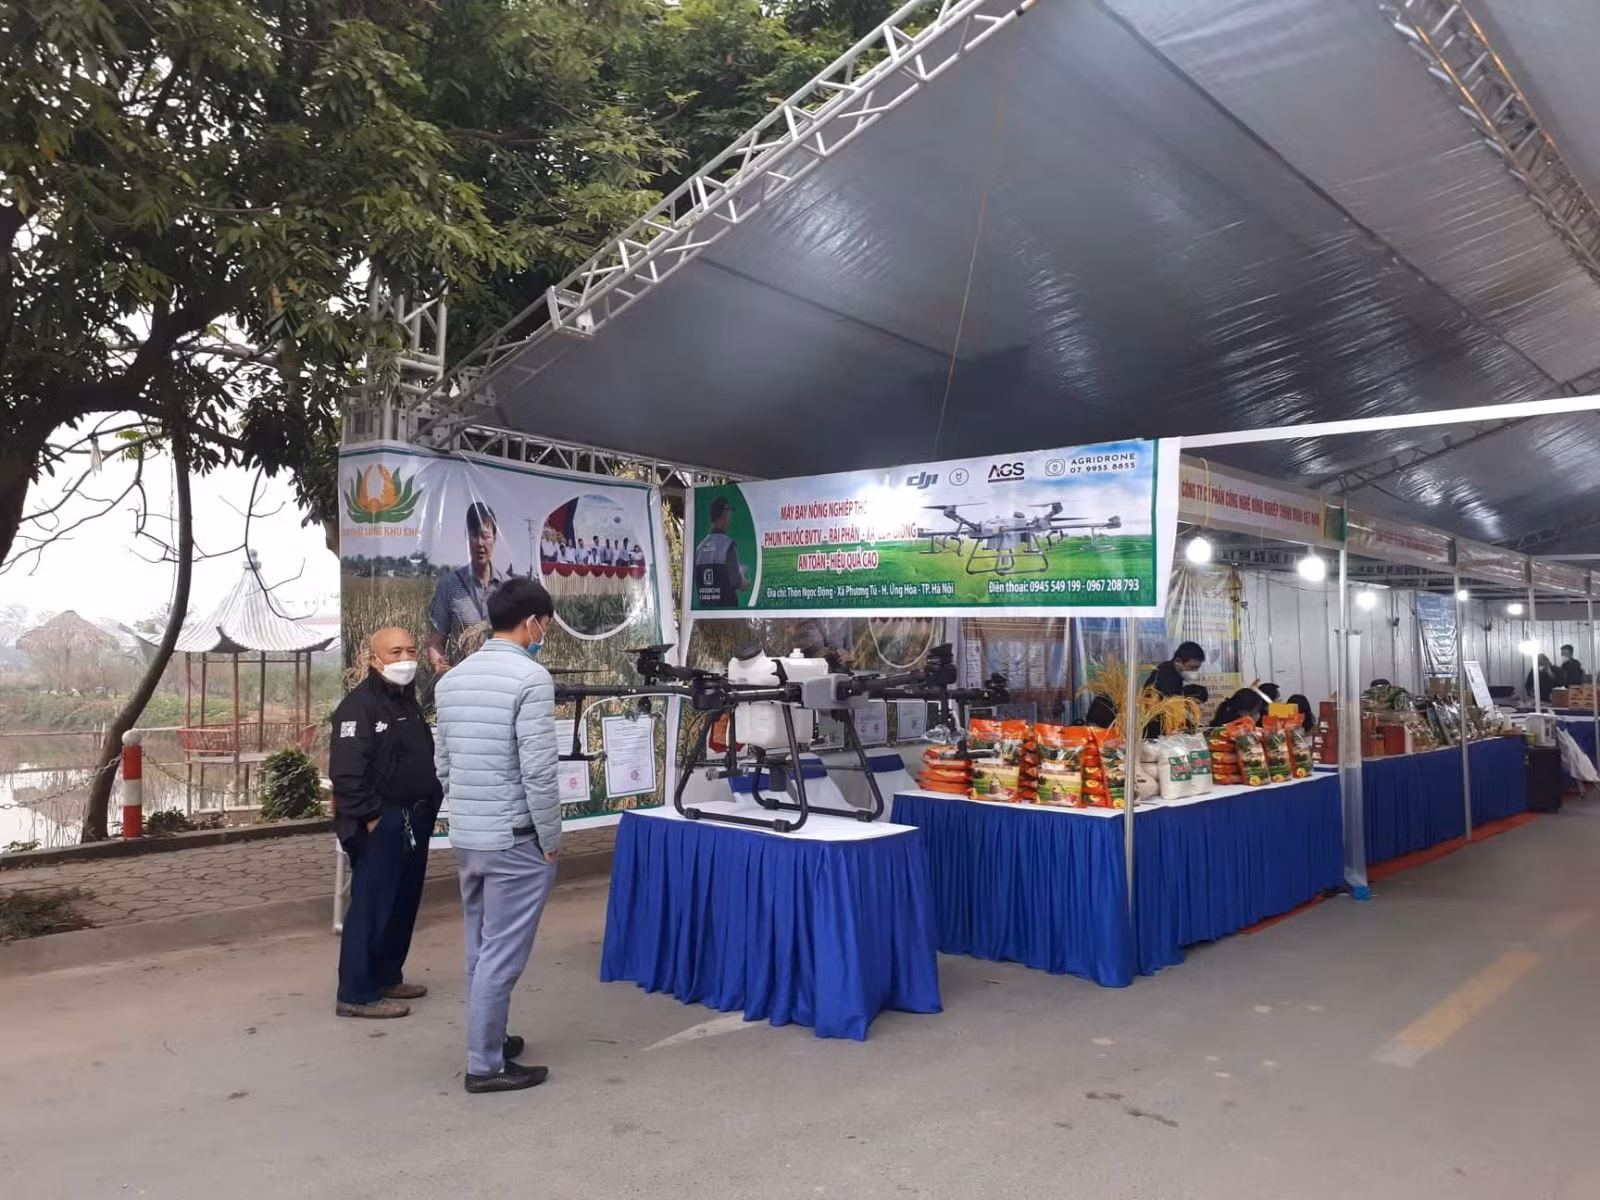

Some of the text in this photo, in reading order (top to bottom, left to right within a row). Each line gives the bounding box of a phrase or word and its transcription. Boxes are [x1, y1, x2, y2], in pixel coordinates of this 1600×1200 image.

[1071, 453, 1136, 465] AGRIDRONE
[988, 462, 1025, 478] AGS
[781, 503, 794, 520] MÁY
[795, 504, 808, 519] BAY
[809, 501, 828, 519] NÔNG
[829, 498, 854, 519] NGHIỆP
[765, 532, 782, 546] PHUN
[782, 527, 804, 545] THUỐC
[805, 528, 822, 544] BVTV
[829, 523, 840, 542] RẢI
[841, 523, 860, 541] PHÂN
[799, 547, 878, 573] AN TOÀN HIỆU QUẢ CAO
[837, 584, 845, 596] Xã
[922, 583, 931, 594] TP.
[932, 582, 941, 594] Hà
[942, 582, 954, 597] Nội
[988, 580, 1004, 595] Điện
[1030, 580, 1049, 592] 0945
[1051, 580, 1065, 592] 549
[1067, 580, 1081, 592] 199
[1086, 579, 1105, 592] 0967
[1107, 579, 1121, 591] 208
[1124, 579, 1139, 591] 793
